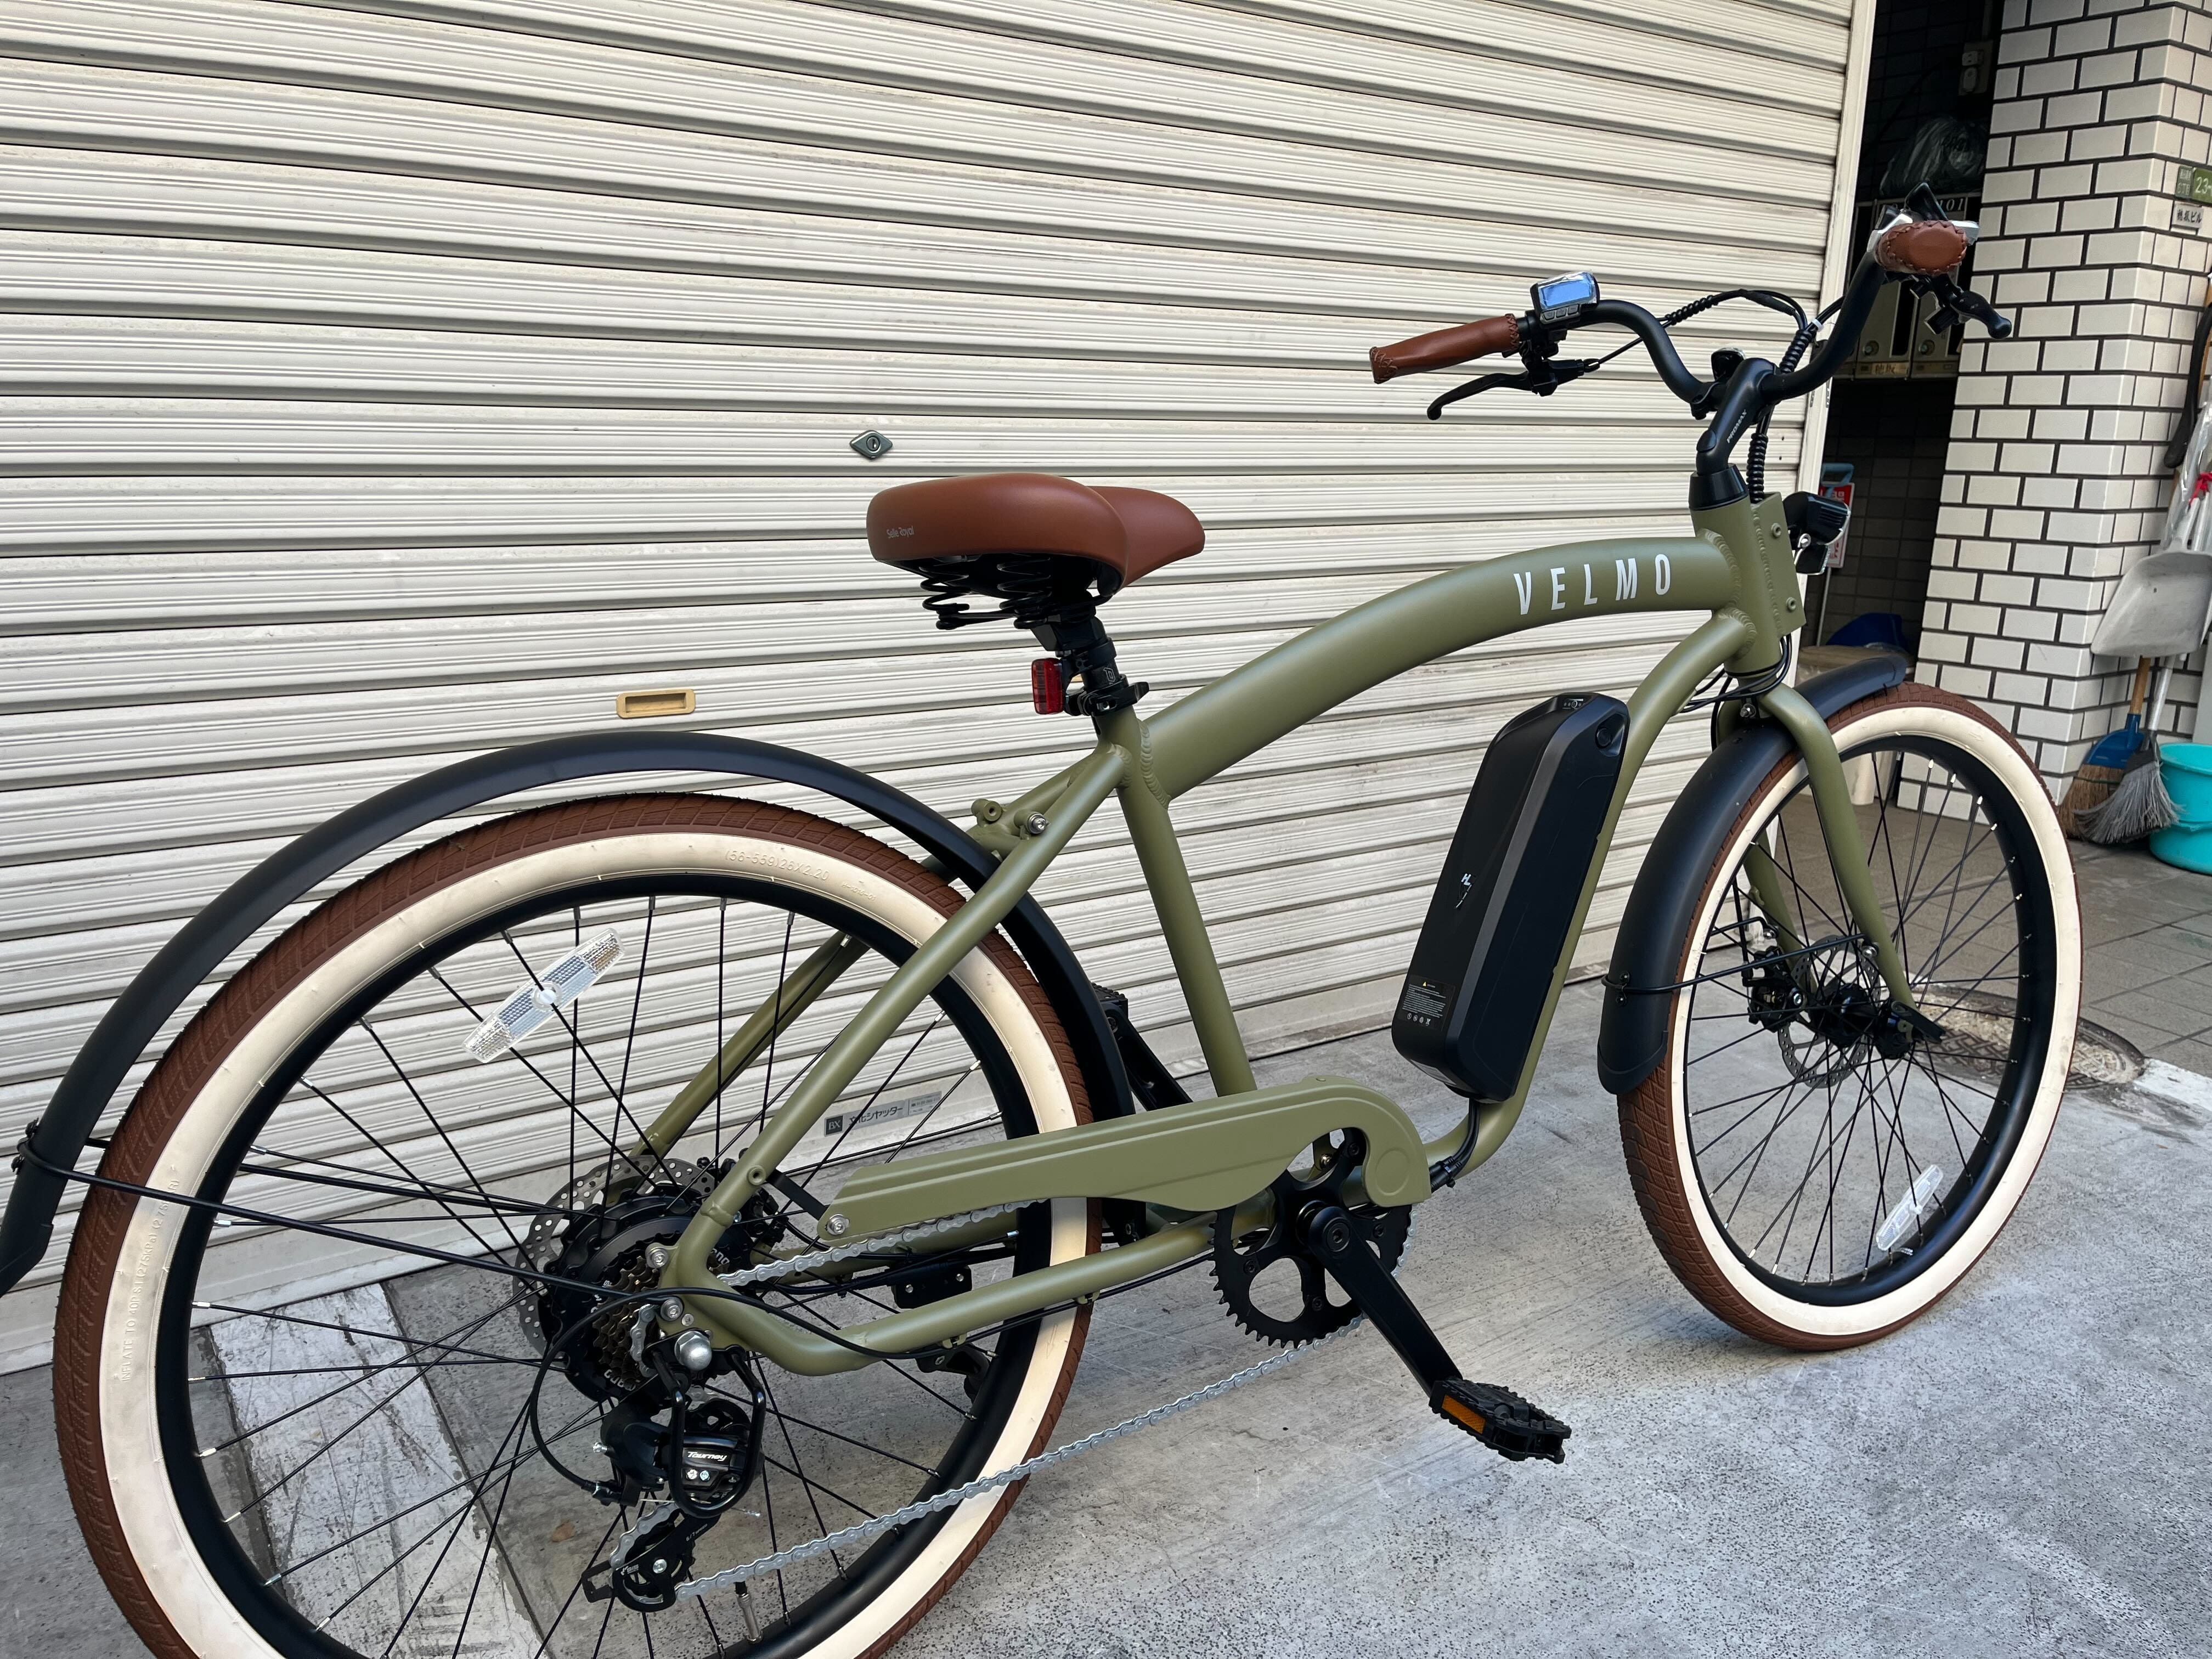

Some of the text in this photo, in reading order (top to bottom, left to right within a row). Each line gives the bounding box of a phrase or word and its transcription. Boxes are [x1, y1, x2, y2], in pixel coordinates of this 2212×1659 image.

[1726, 409, 1747, 443] PROMAX
[886, 528, 899, 539] Selle
[1513, 553, 1672, 616] VELMO
[828, 1119, 842, 1130] BX
[124, 1318, 135, 1336] TO
[120, 1338, 133, 1383] INFLATE
[687, 1451, 728, 1462] Tourney
